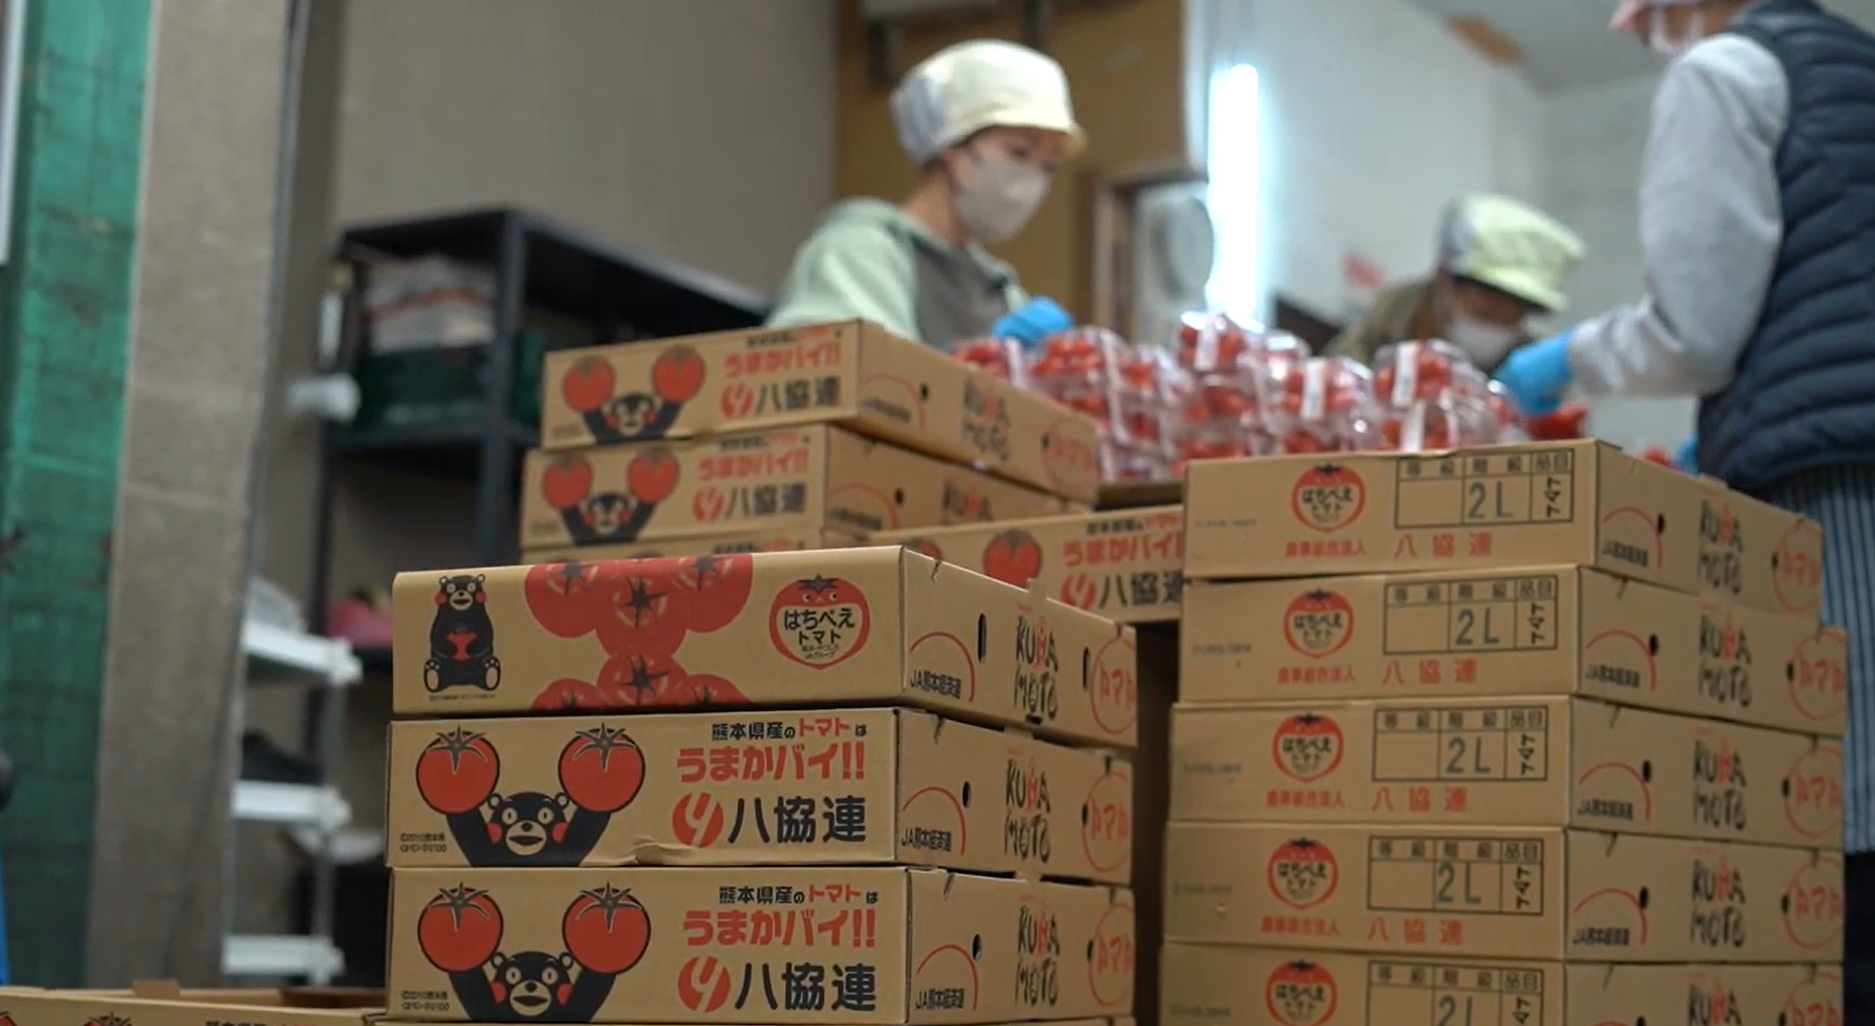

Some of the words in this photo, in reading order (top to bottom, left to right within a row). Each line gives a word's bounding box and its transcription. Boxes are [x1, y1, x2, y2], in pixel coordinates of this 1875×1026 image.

[784, 608, 855, 630] はちべえ
[799, 630, 841, 645] トマト
[712, 717, 867, 741] 熊本県産のトマトは
[677, 741, 865, 783] うまかバイ!!
[727, 795, 866, 844] 八協連
[719, 884, 879, 904] 熊本県産のトマトは
[683, 908, 876, 948] うまかバイ!!
[735, 962, 876, 1011] 八協連
